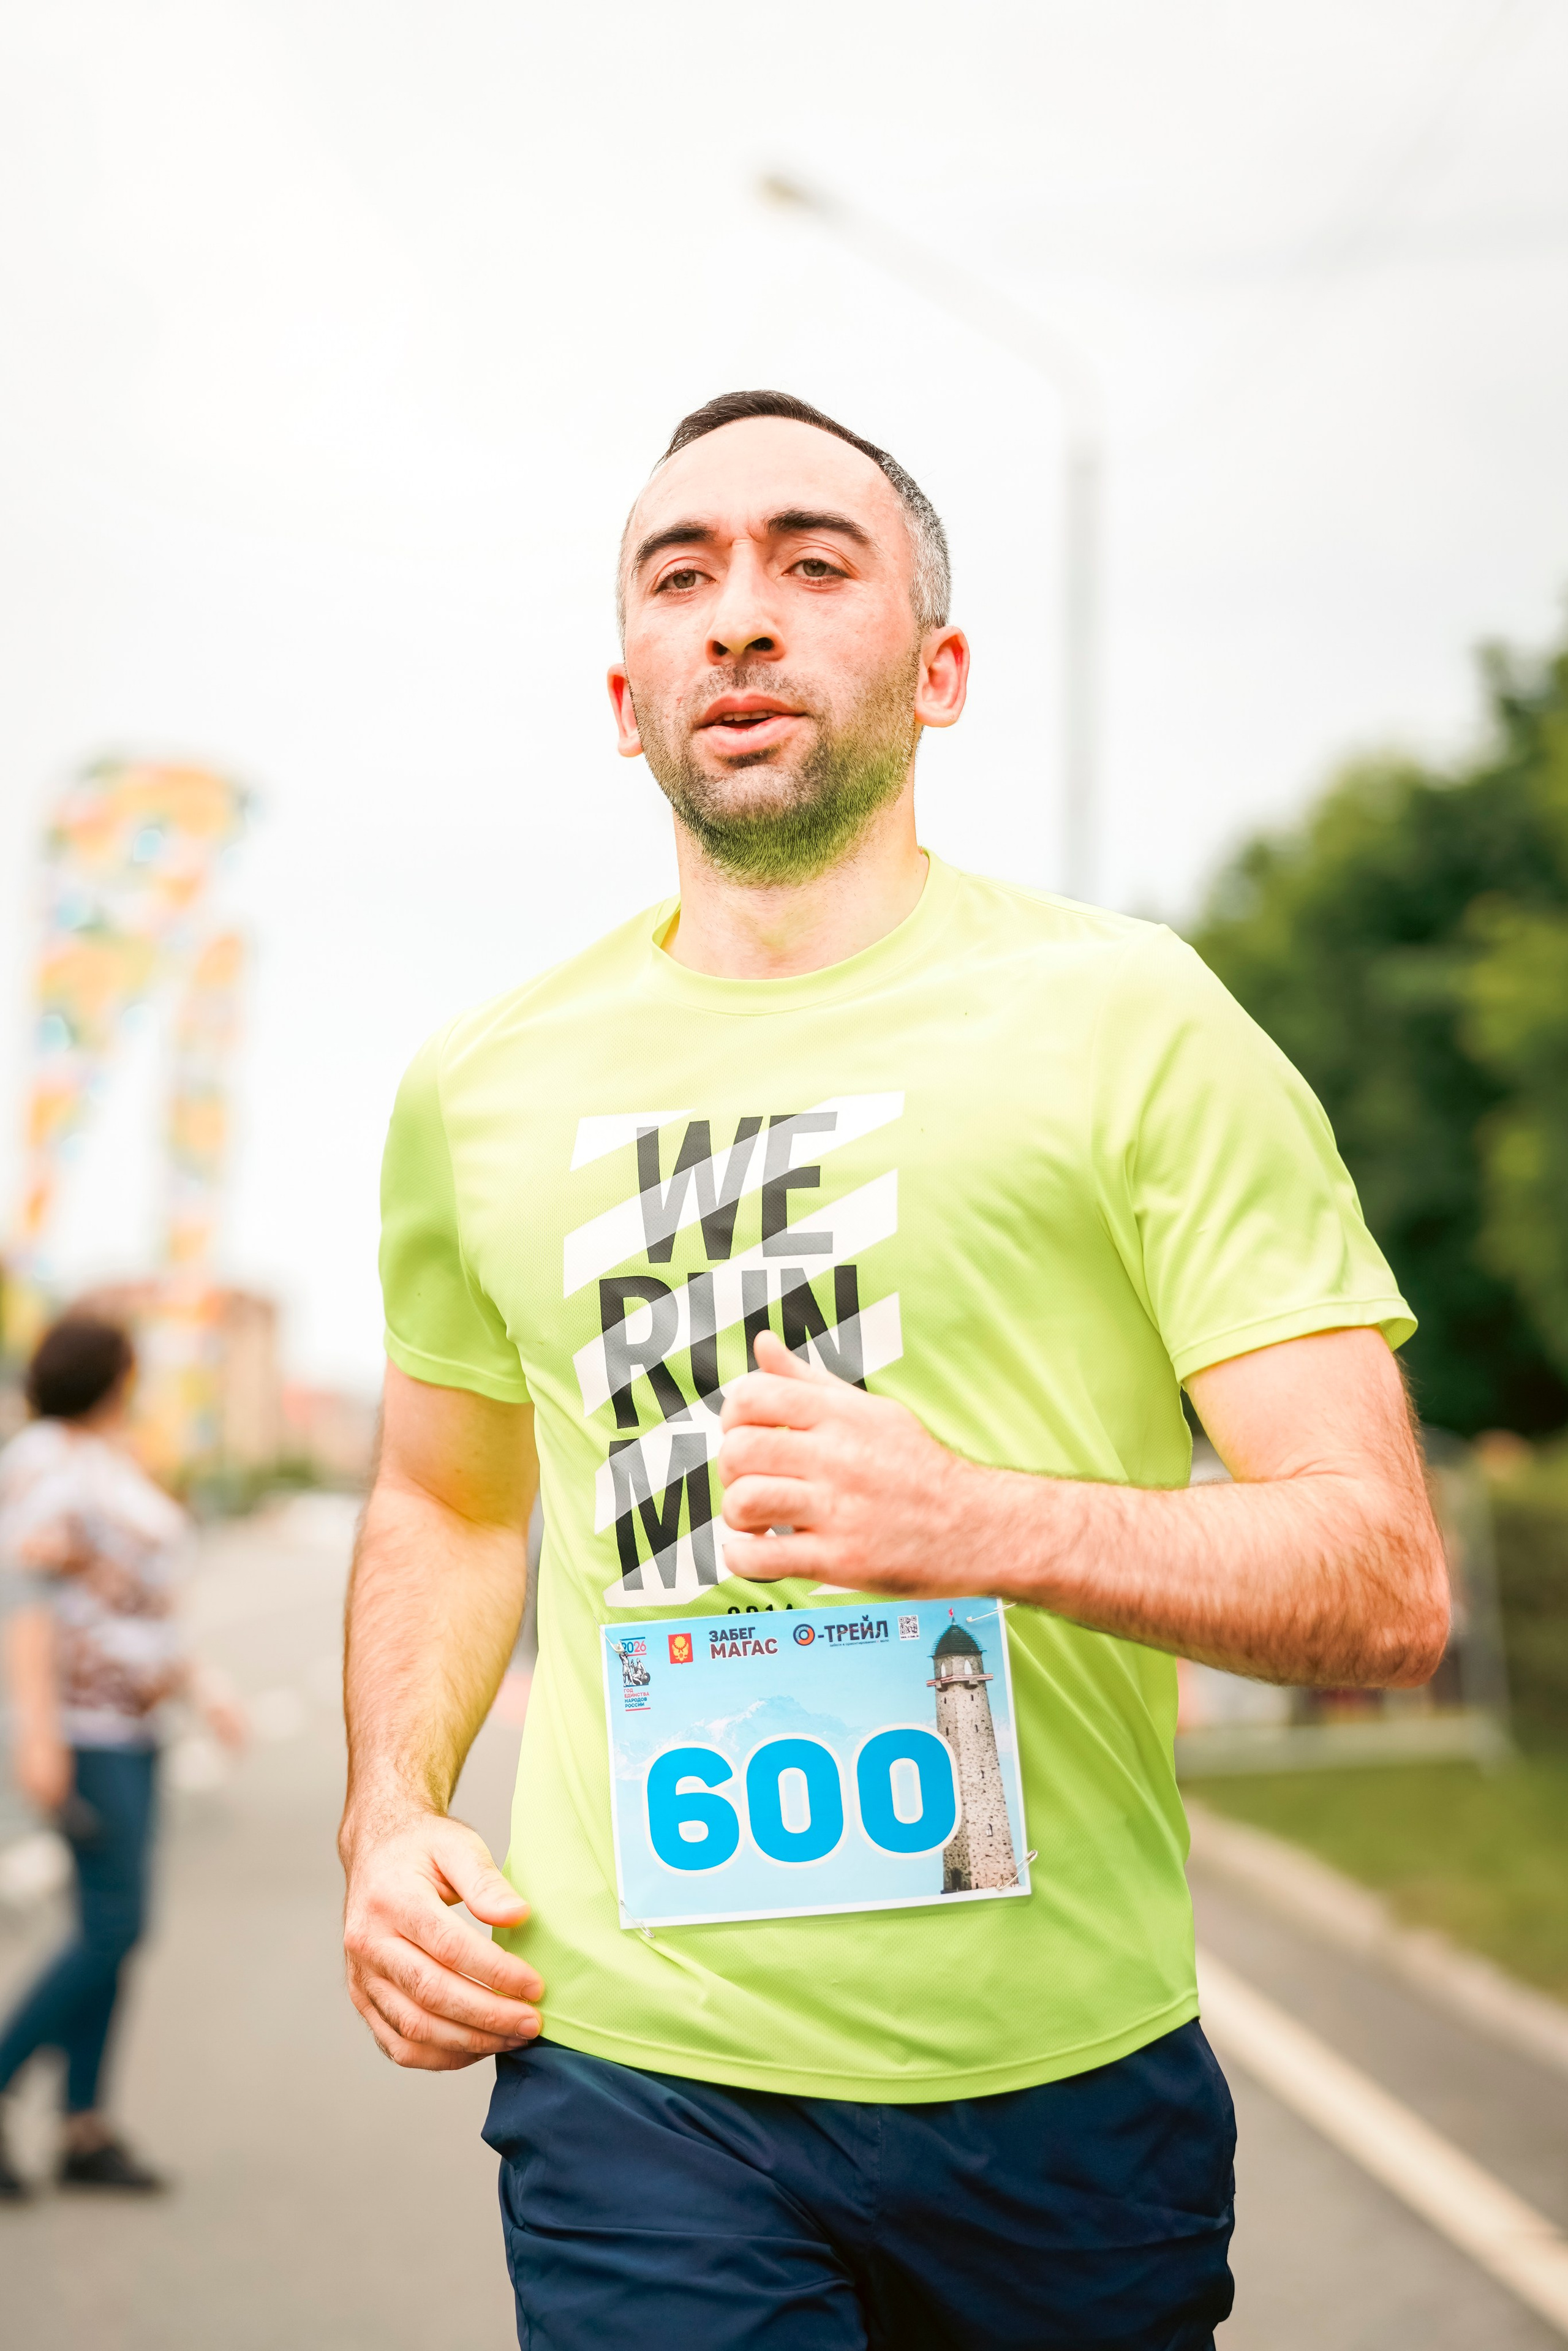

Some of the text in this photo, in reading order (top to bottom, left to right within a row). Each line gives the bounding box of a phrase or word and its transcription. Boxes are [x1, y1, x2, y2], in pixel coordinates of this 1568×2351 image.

[636, 1111, 838, 1264] WE
[598, 1264, 868, 1429] RUN
[708, 1626, 756, 1643] ЗАБЕГ
[710, 1638, 778, 1659] МАГАС
[646, 1728, 957, 1872] 600
